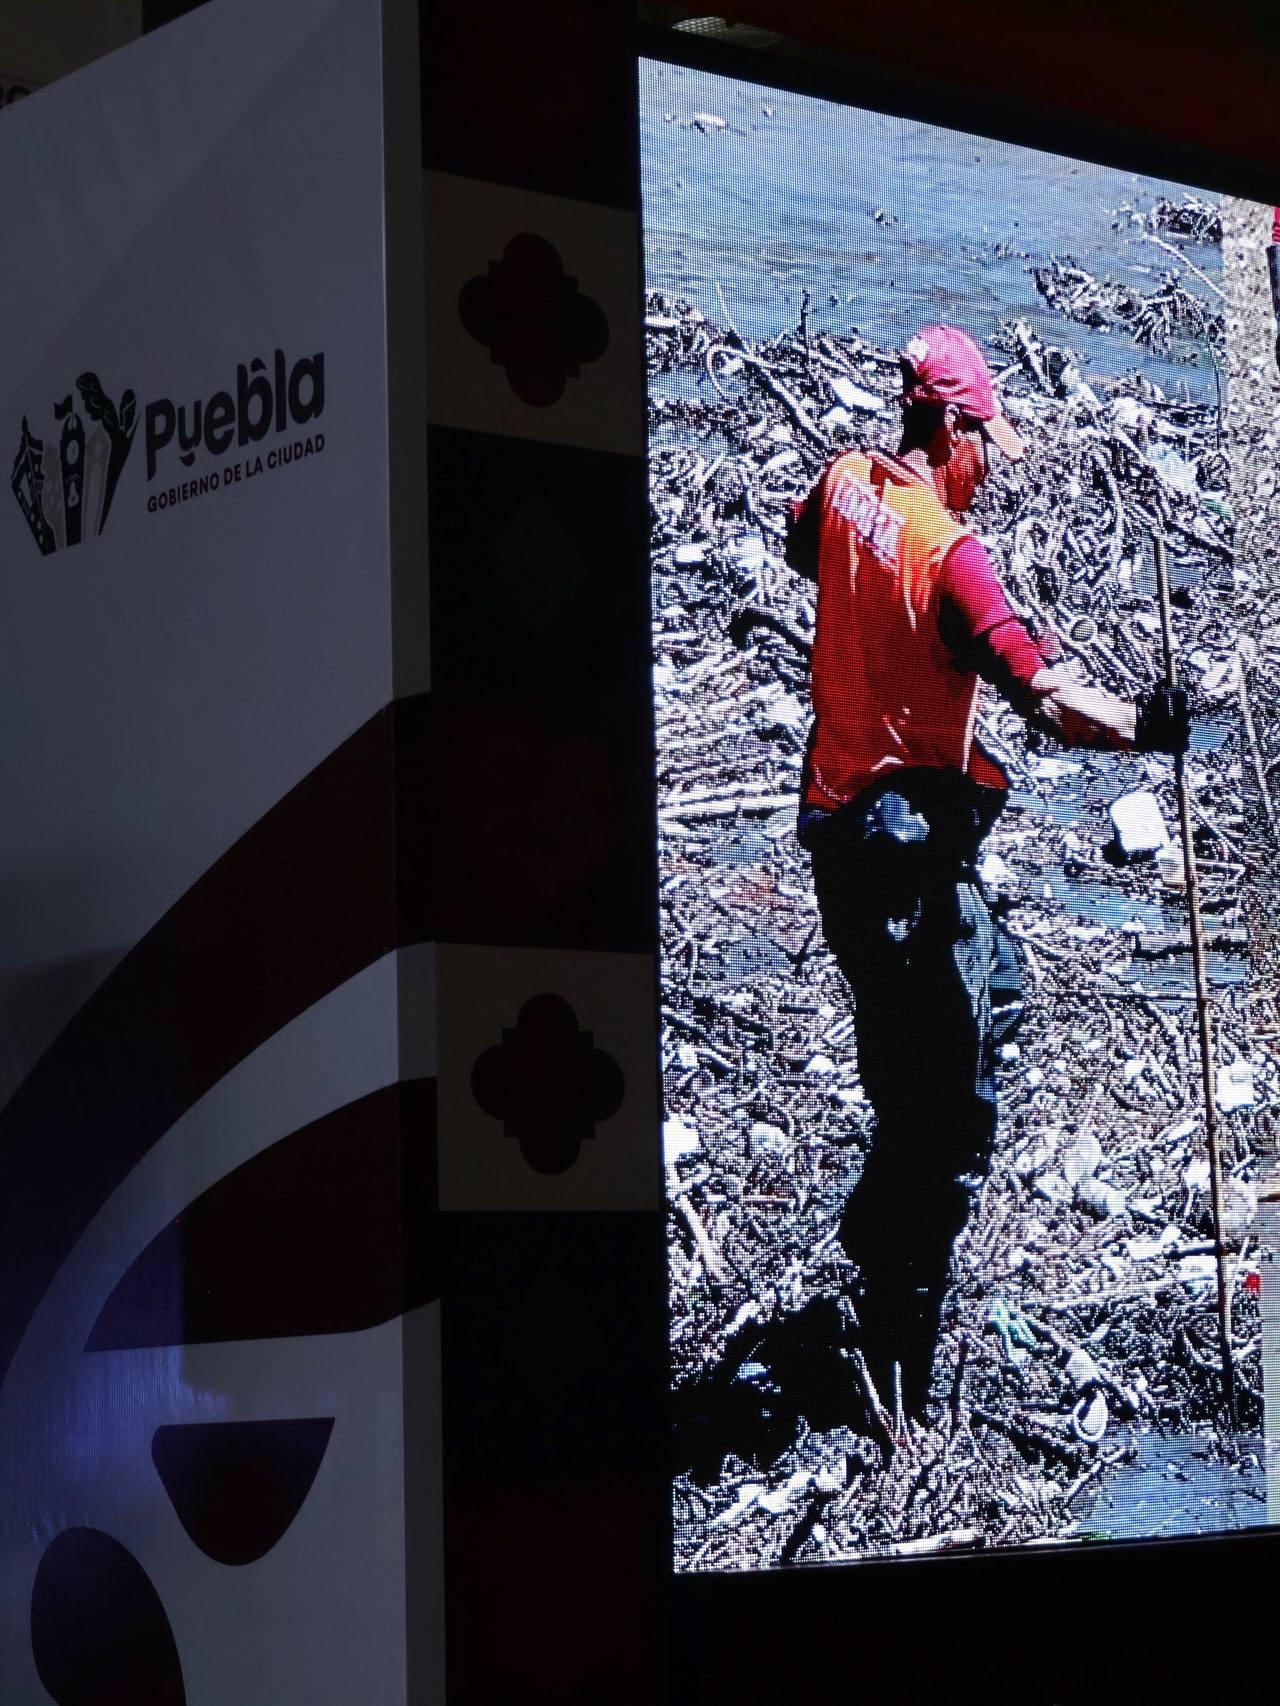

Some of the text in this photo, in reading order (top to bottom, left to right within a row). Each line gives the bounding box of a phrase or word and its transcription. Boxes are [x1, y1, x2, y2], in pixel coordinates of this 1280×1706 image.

[145, 348, 326, 482] Puebla
[147, 433, 326, 513] GOBIERNO DE LA CIUDAD
